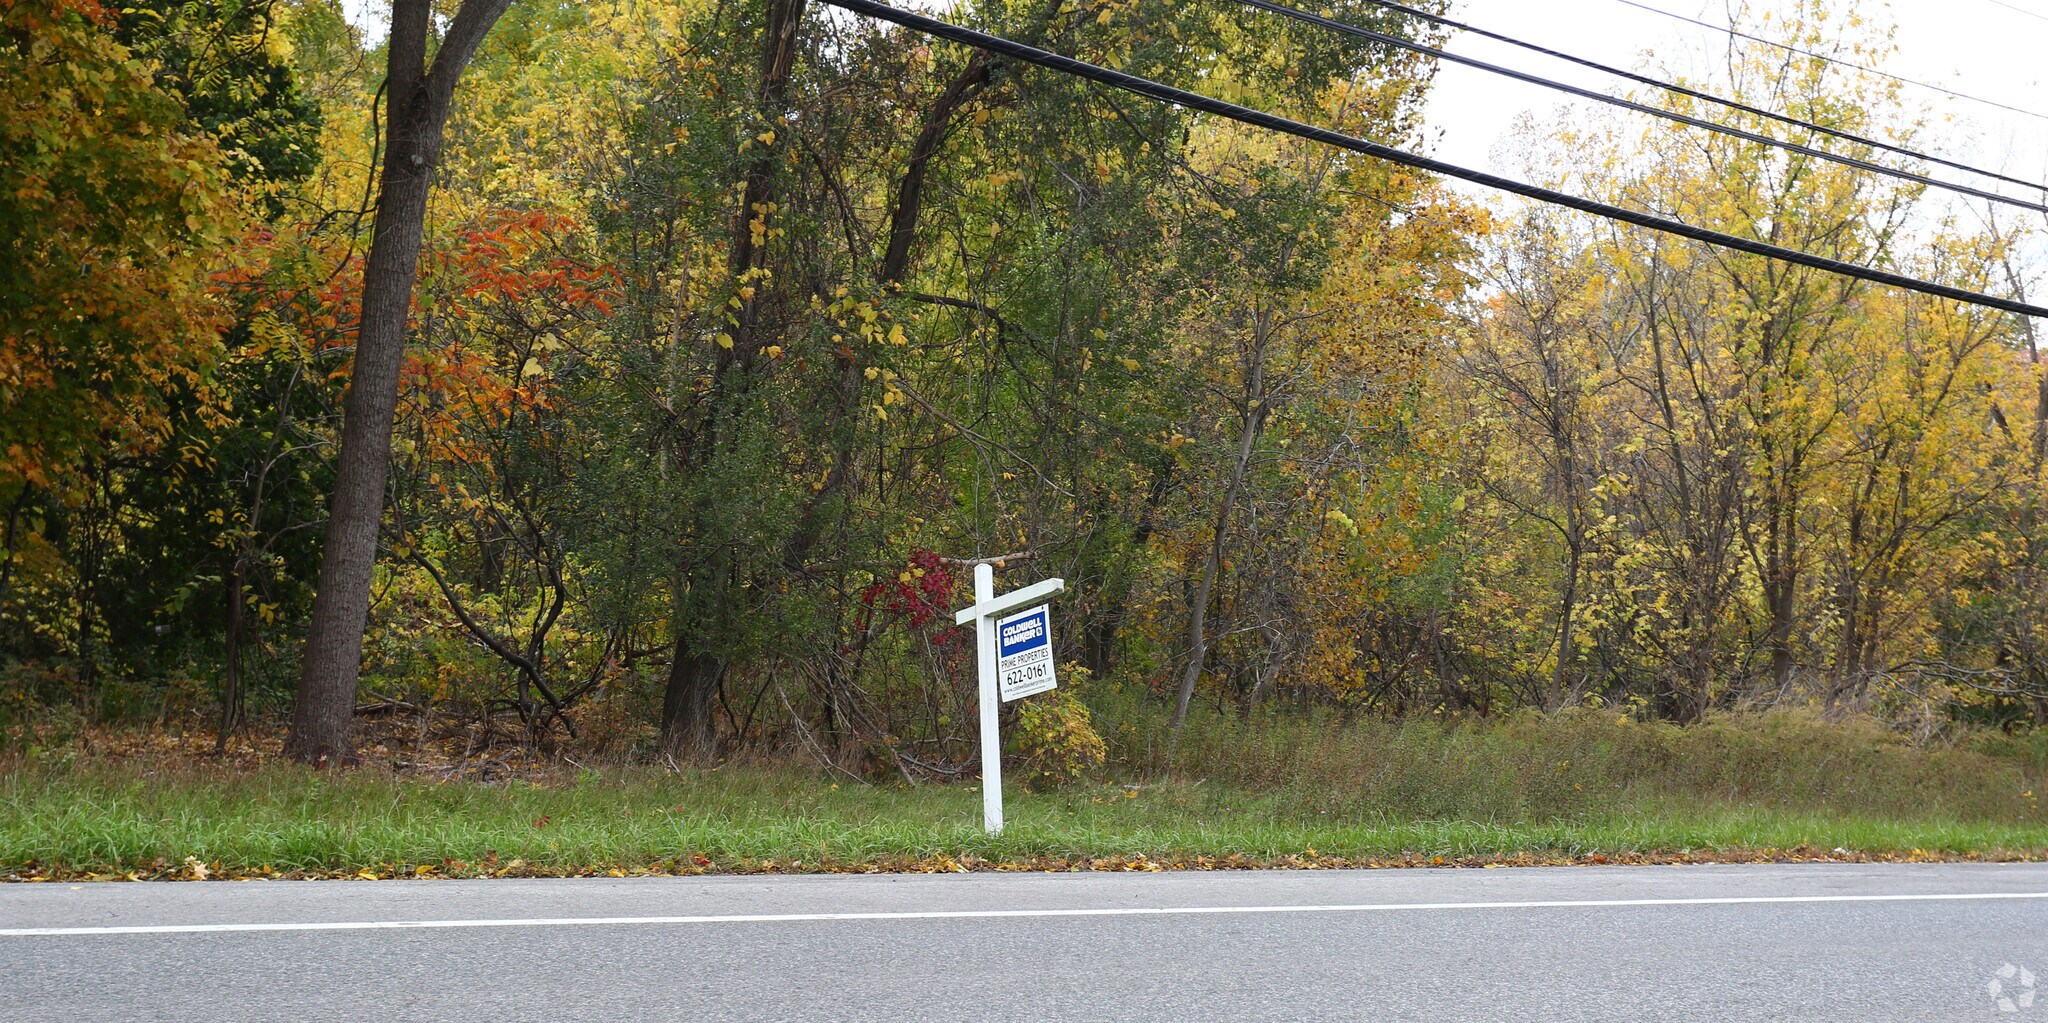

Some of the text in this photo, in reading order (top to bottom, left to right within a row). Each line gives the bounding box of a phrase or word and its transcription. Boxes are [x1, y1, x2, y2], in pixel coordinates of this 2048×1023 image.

[1001, 647, 1049, 670] PRIME PROPERTIES
[1007, 663, 1047, 686] 622-0161
